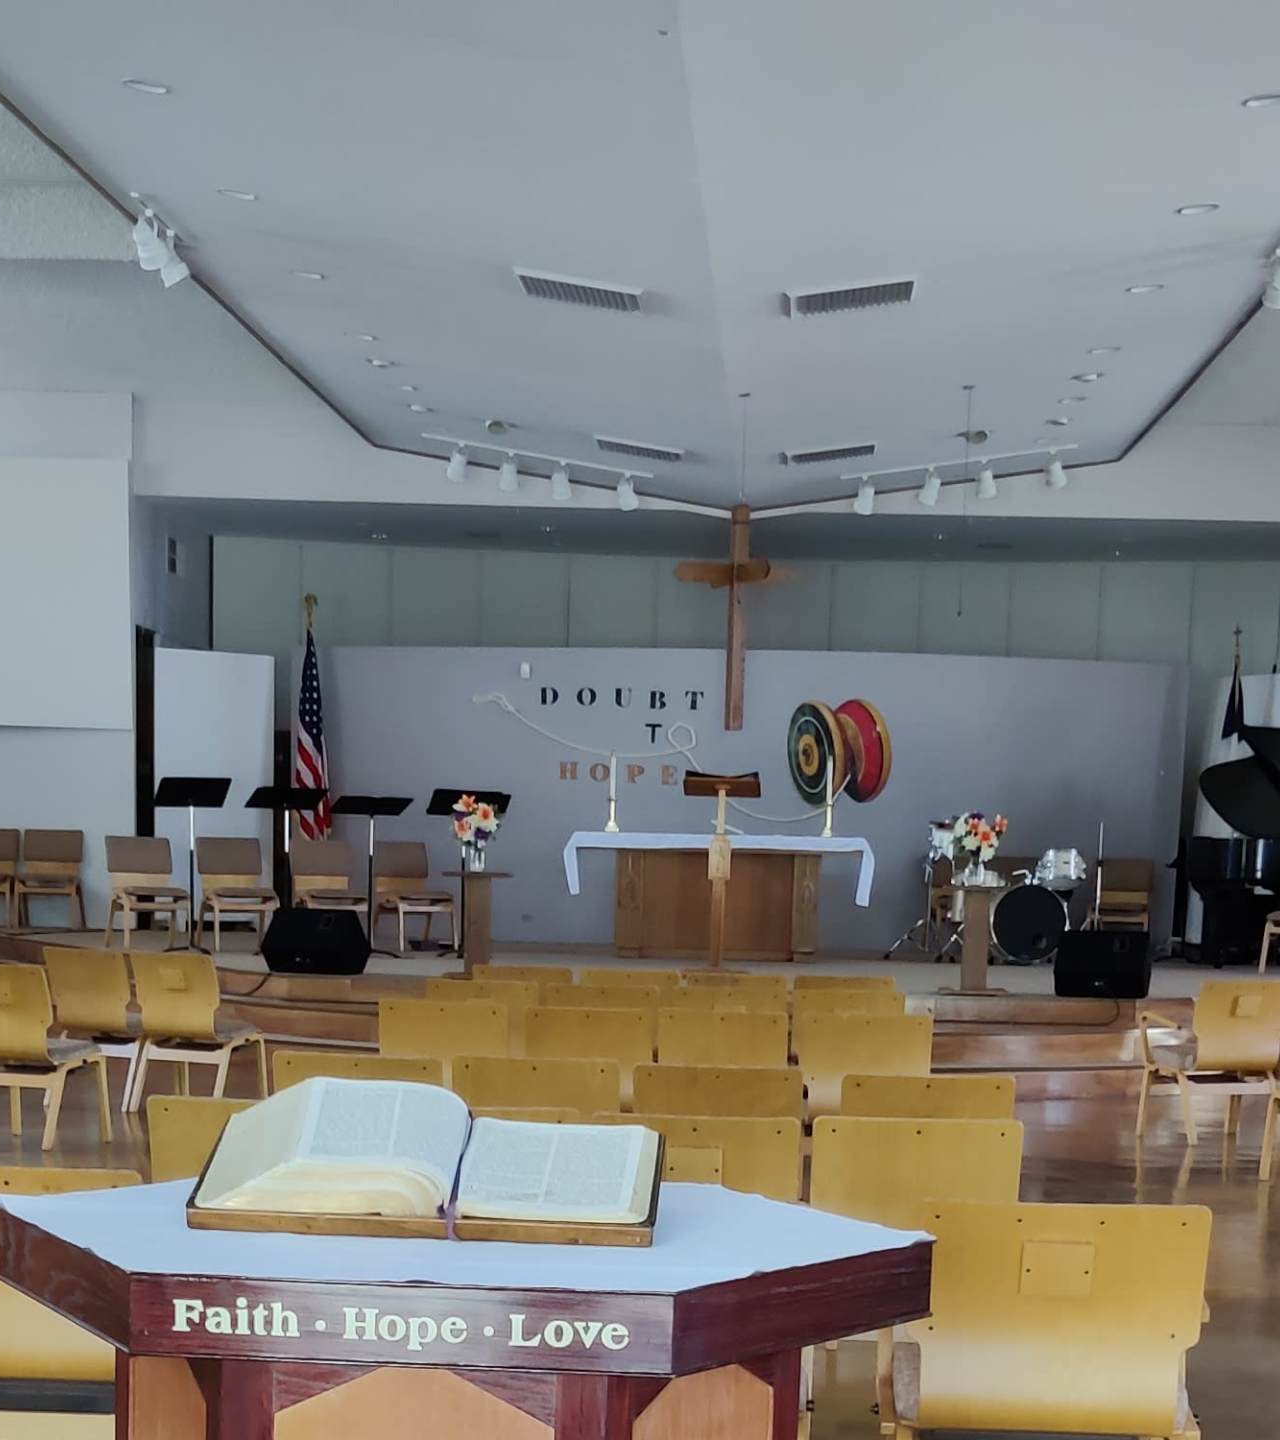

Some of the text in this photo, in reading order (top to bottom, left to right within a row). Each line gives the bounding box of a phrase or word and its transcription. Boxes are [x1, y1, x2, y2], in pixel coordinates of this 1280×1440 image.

[540, 686, 704, 711] DOUBT
[559, 761, 678, 786] HOPE
[172, 1297, 630, 1351] Faith Hope Love
